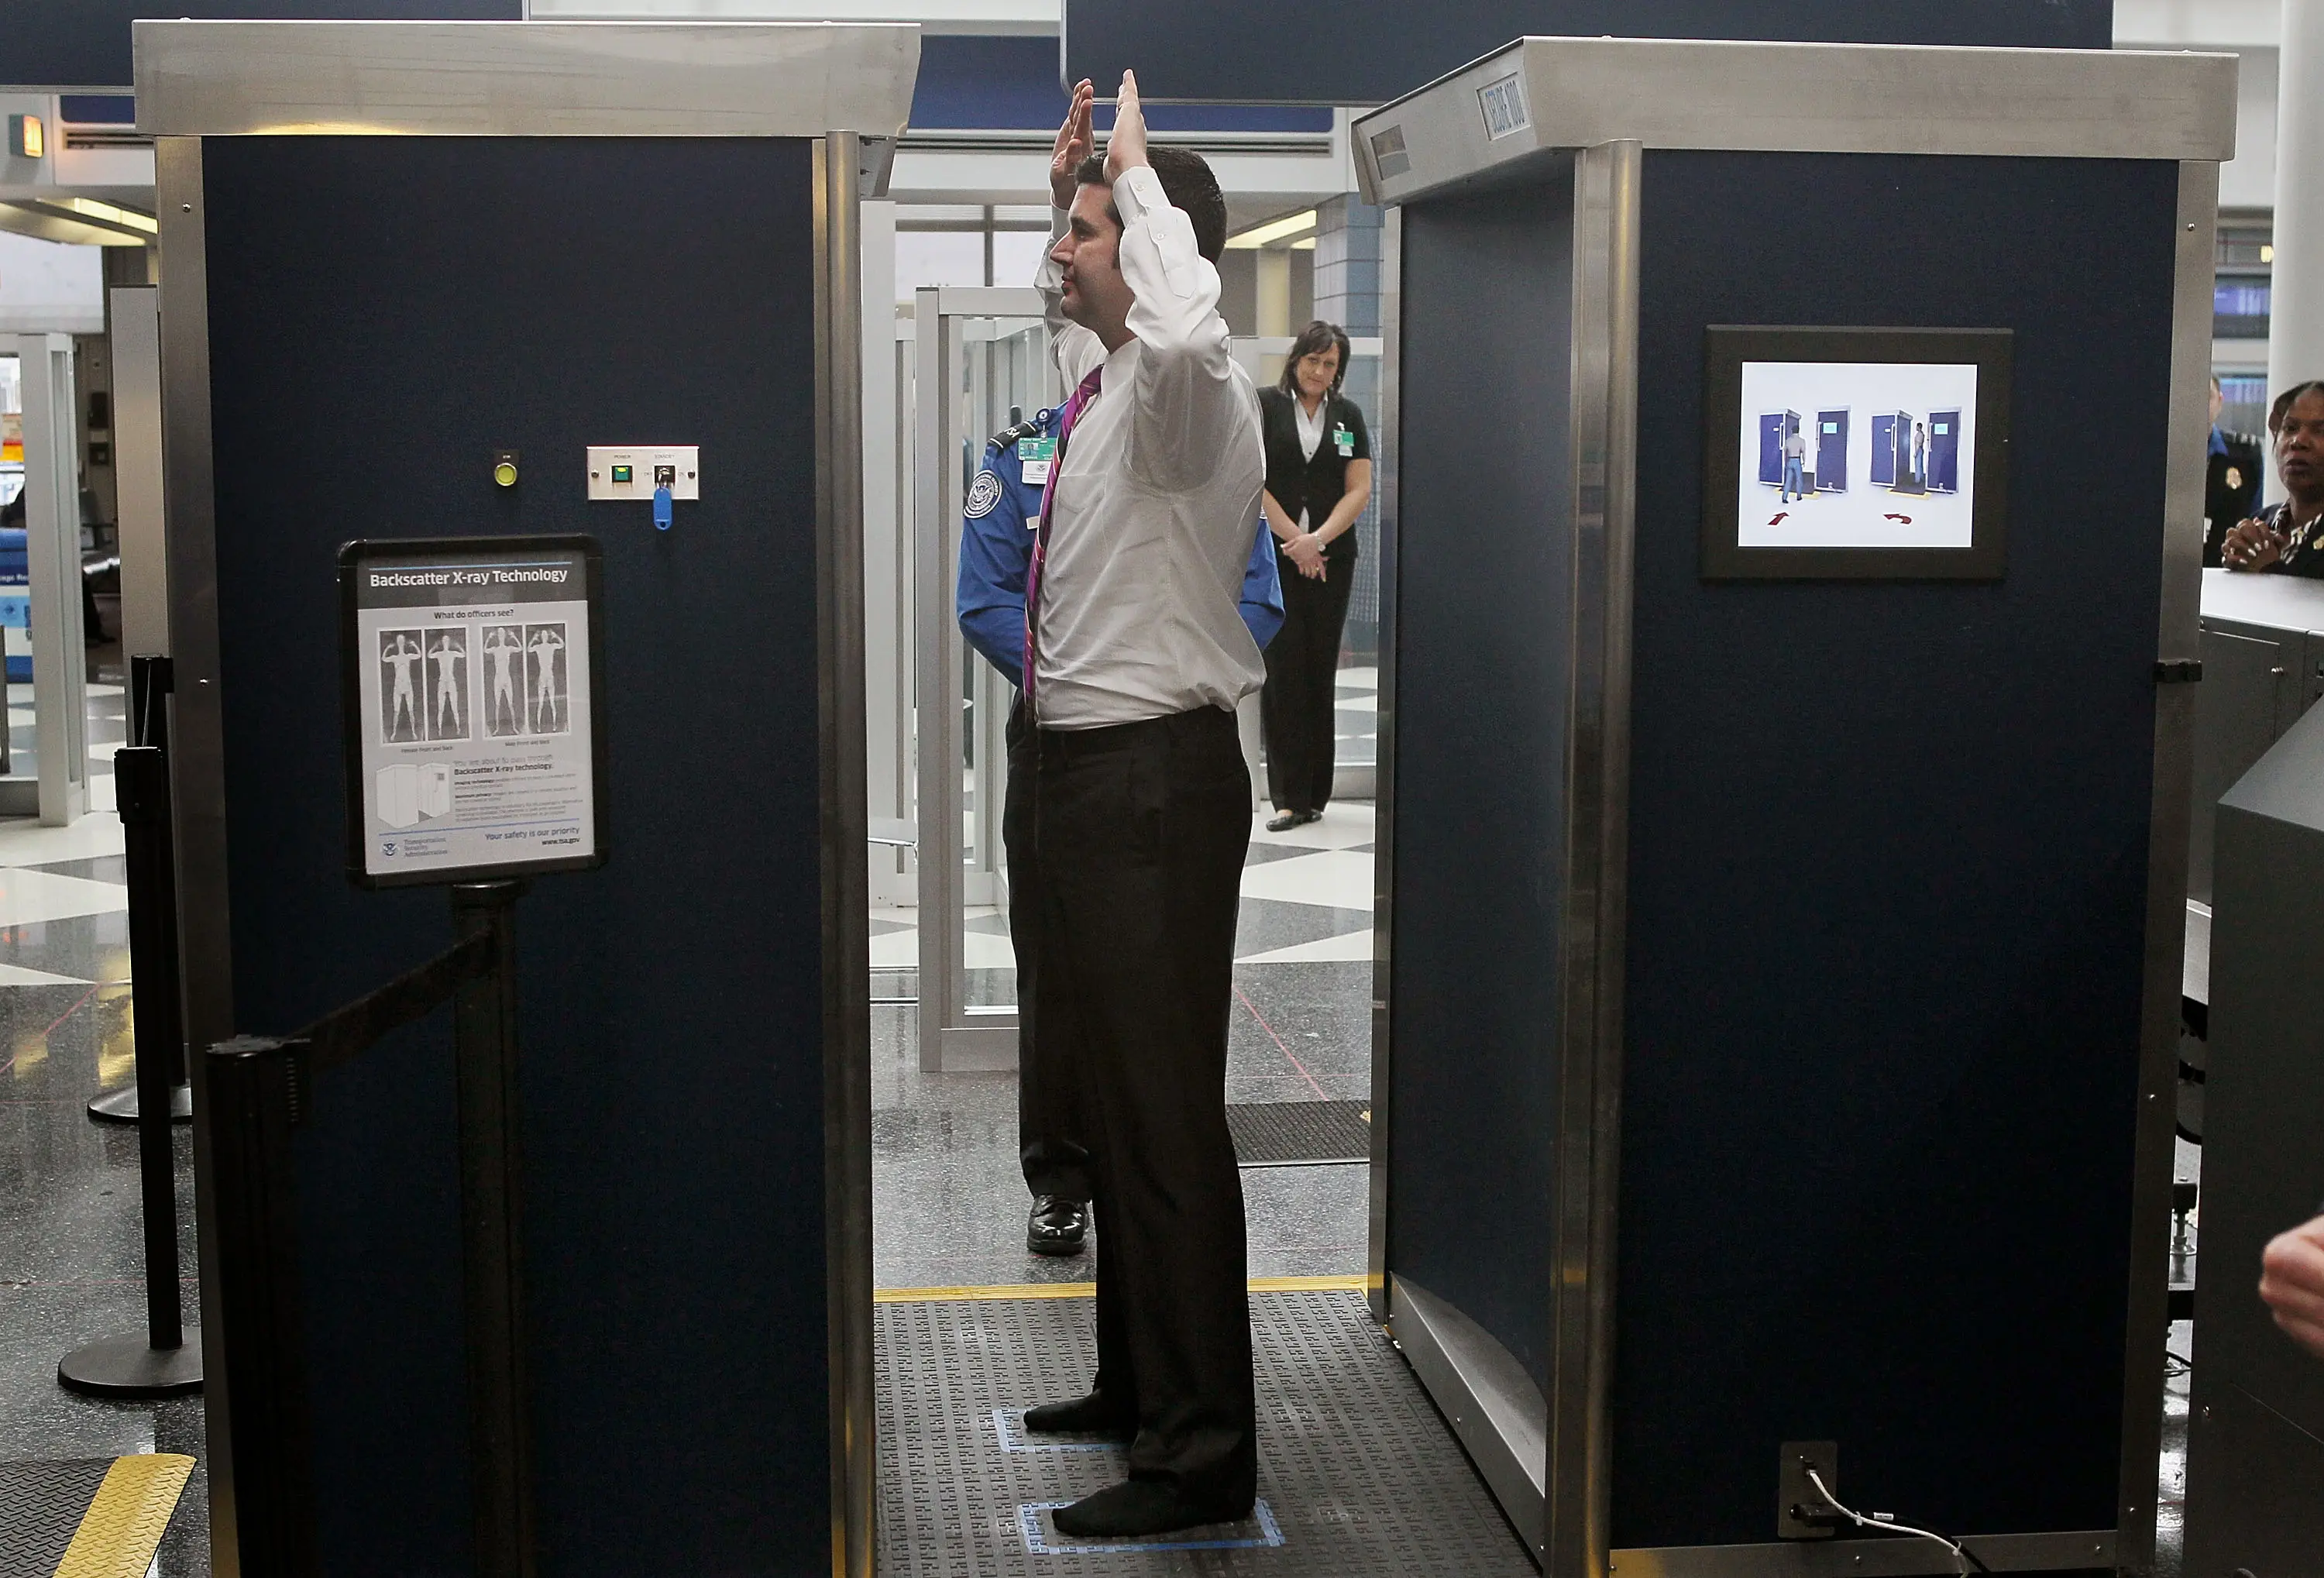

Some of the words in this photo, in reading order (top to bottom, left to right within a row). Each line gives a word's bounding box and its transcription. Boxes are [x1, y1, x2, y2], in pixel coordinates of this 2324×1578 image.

[1004, 427, 1020, 438] TSA
[370, 572, 449, 586] Backscatter
[453, 571, 490, 586] X-ray
[493, 569, 568, 583] Technology
[467, 610, 496, 618] officers
[454, 766, 493, 775] Backscatter
[504, 831, 527, 840] safety
[551, 827, 579, 836] priority
